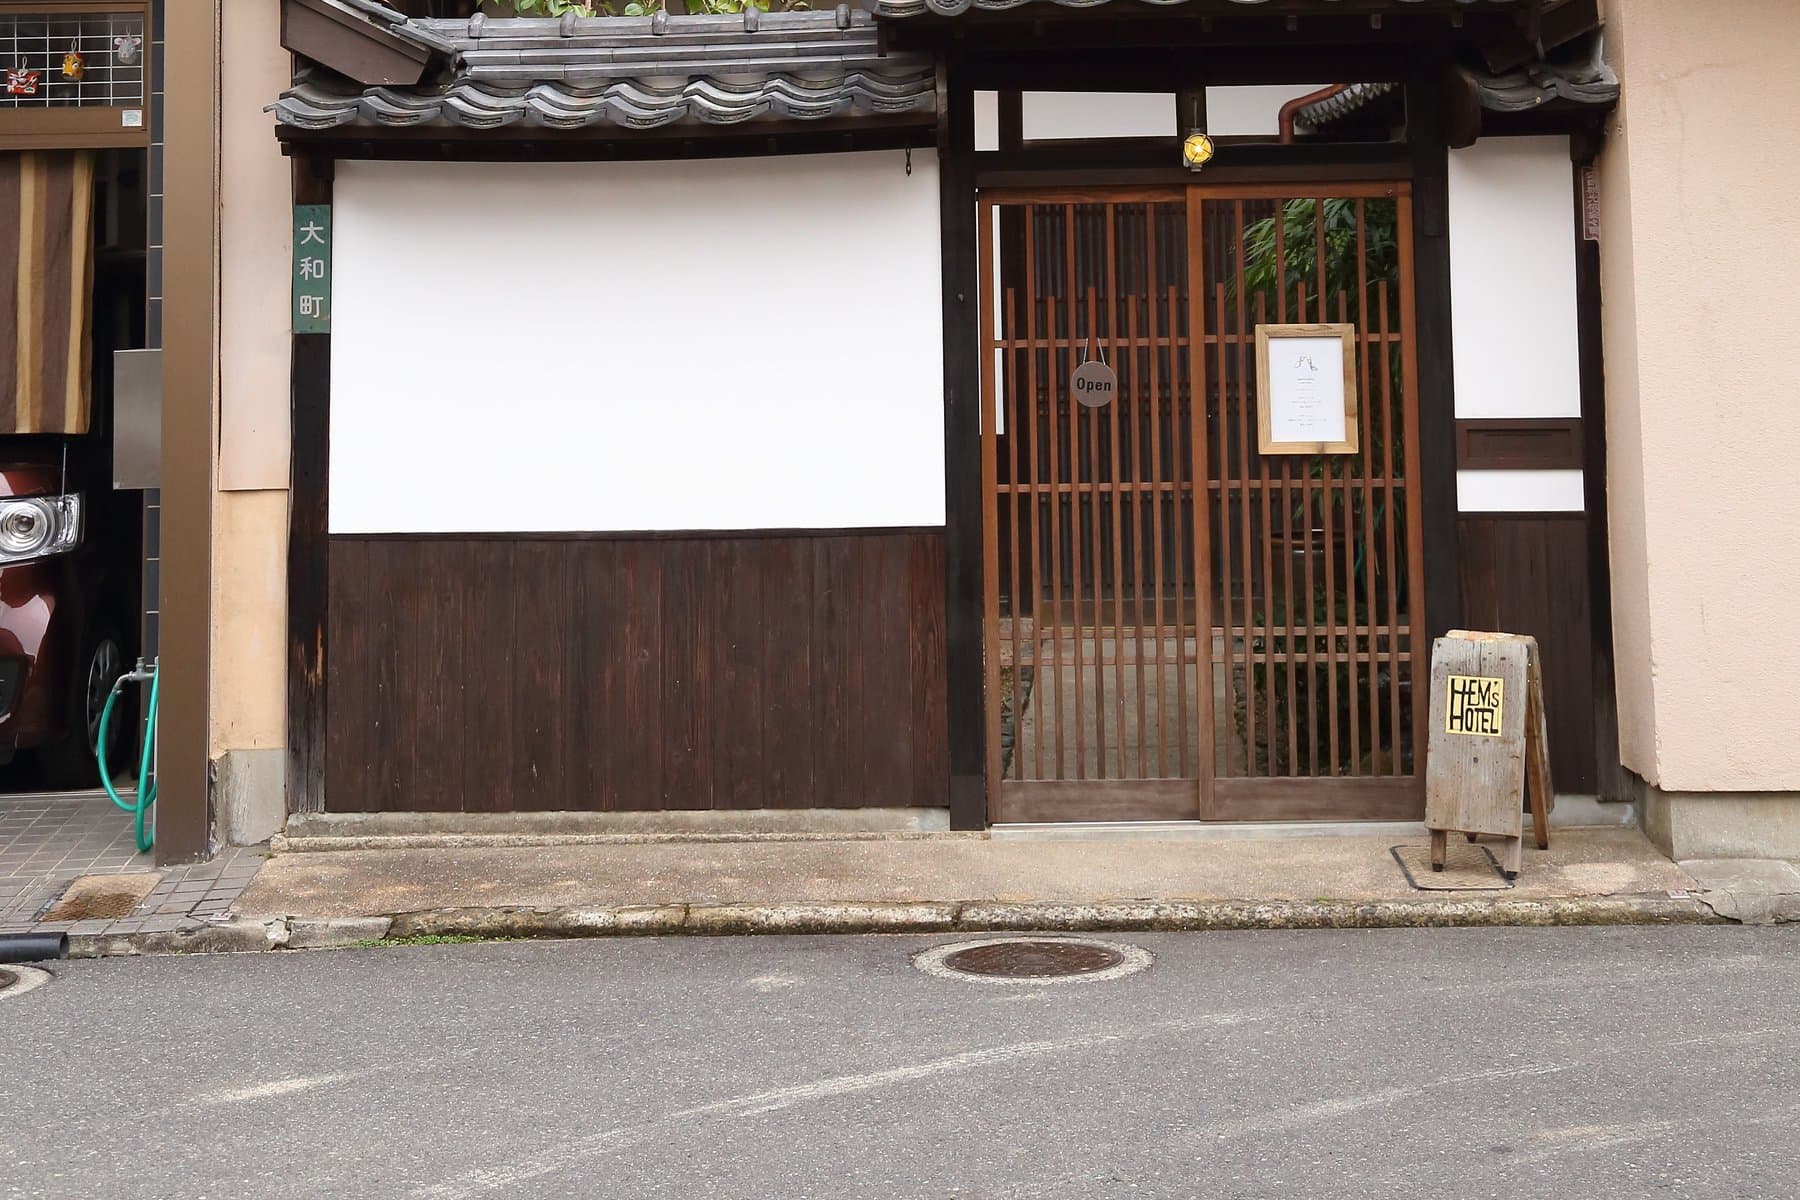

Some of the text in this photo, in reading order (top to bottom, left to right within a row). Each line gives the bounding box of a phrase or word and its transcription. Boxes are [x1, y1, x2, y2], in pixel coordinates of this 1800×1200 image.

[299, 220, 325, 318] 大和町
[1076, 377, 1111, 393] Open
[1449, 708, 1499, 733] HOTEL
